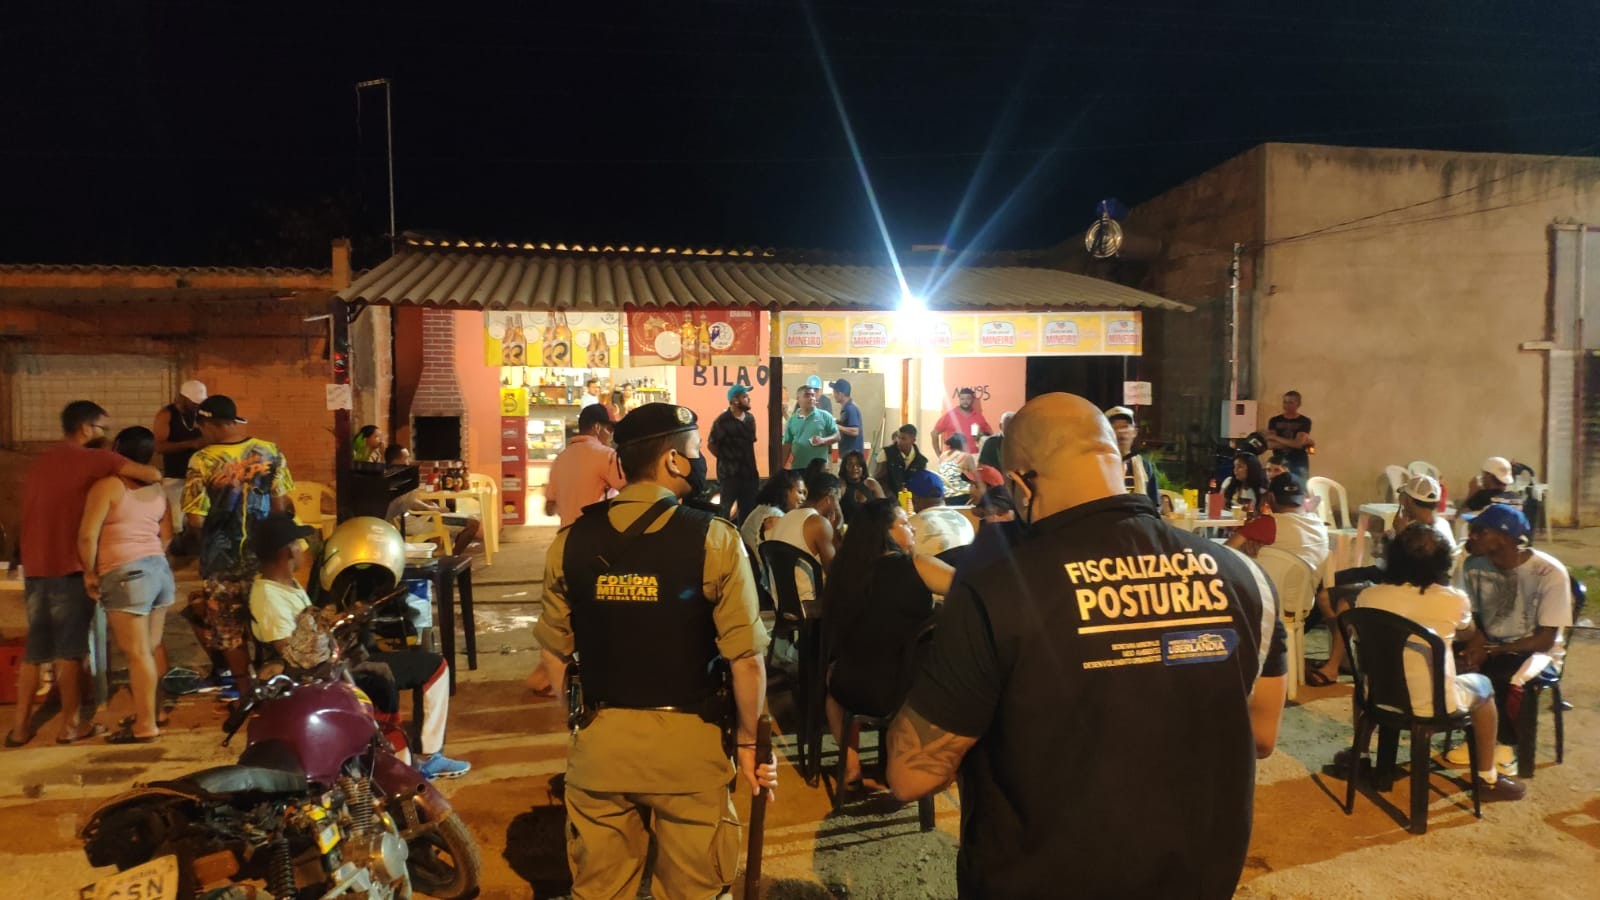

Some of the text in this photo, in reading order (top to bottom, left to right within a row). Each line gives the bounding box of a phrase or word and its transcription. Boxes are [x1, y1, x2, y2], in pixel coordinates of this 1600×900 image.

[1064, 548, 1219, 584] FISCALIZAÇÃO
[596, 585, 659, 596] MILITAR
[1075, 579, 1229, 620] POSTURAS
